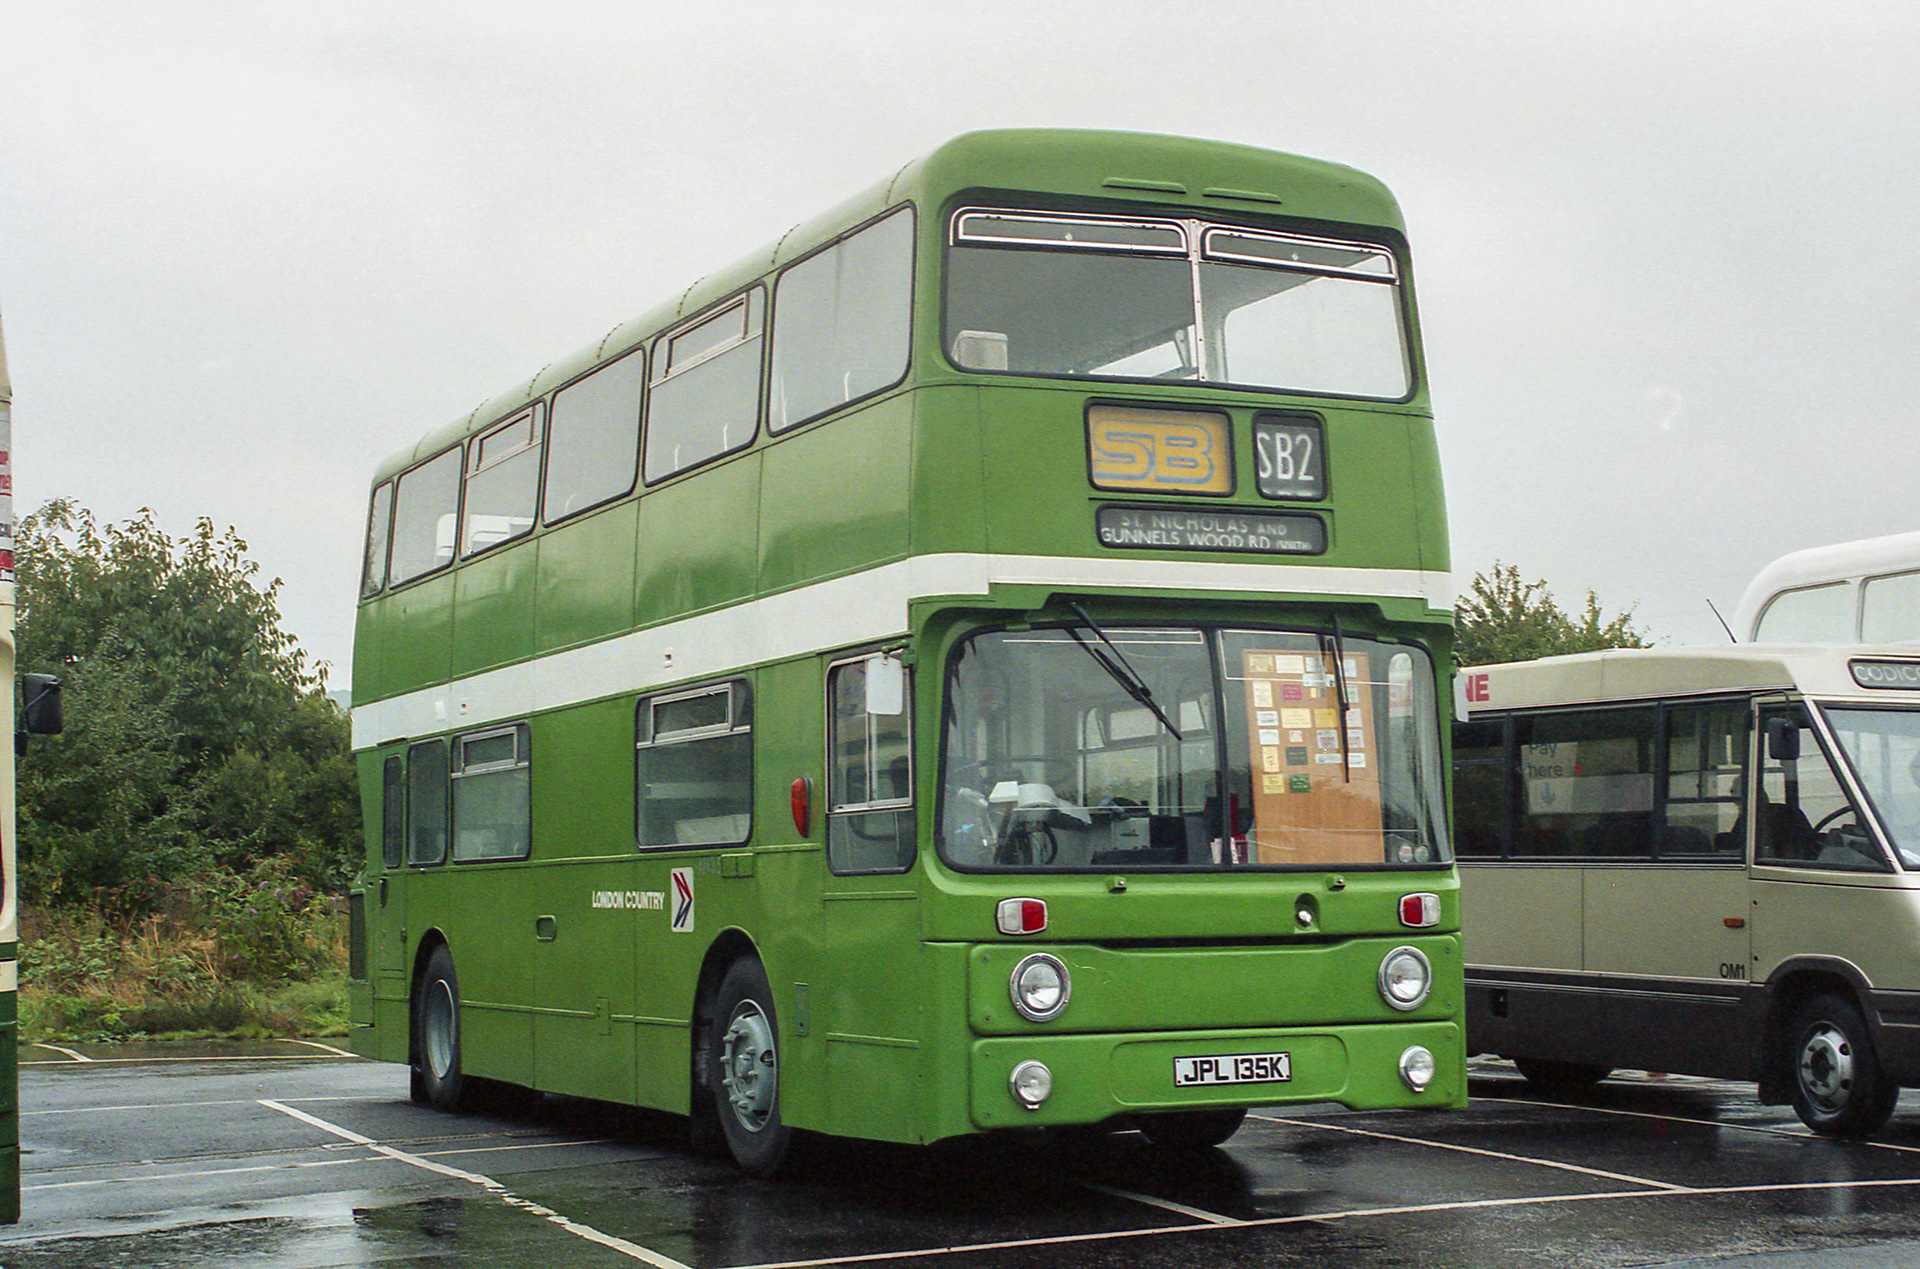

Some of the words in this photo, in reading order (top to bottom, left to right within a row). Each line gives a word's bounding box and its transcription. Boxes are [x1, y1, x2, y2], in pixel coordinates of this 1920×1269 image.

[1092, 417, 1215, 485] SB
[1257, 432, 1315, 481] SB2
[1152, 514, 1249, 533] NICHOLAS
[1256, 524, 1288, 536] AND
[1100, 527, 1180, 546] GUNNELS
[1186, 530, 1244, 549] WOOD
[1248, 534, 1271, 549] RD
[1853, 665, 1920, 681] CODIC
[1527, 763, 1564, 778] here
[591, 890, 624, 909] LONDON
[624, 890, 665, 910] COUNTRY
[1183, 1059, 1230, 1082] JPL
[1233, 1056, 1285, 1081] 135K
